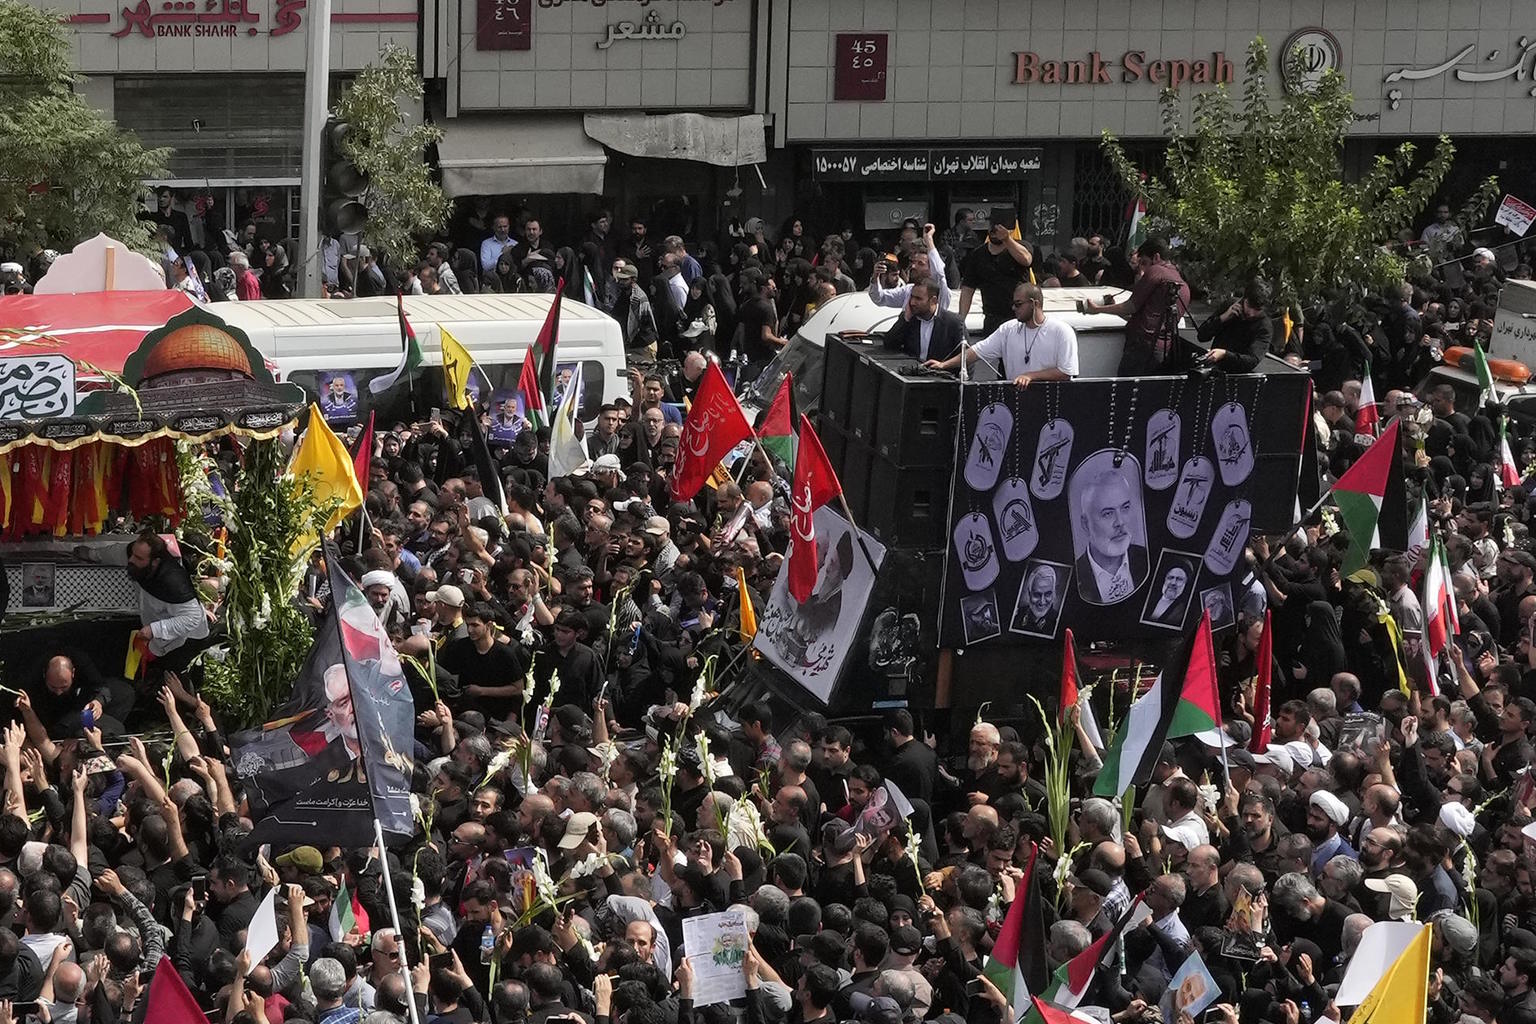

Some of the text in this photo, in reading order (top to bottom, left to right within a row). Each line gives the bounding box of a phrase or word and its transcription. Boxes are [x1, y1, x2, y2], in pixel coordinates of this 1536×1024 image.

[110, 0, 197, 38] شهر
[157, 25, 238, 38] BANK SHAHR
[595, 9, 687, 50] مشعر
[851, 39, 877, 54] 45
[1012, 51, 1235, 90] Bank Sepah
[861, 157, 901, 176] اختصاصی
[903, 155, 927, 172] شناسه
[934, 156, 960, 175] تهران
[962, 155, 989, 174] انقلاب
[991, 155, 1018, 174] میدان
[1020, 155, 1041, 170] شعبه
